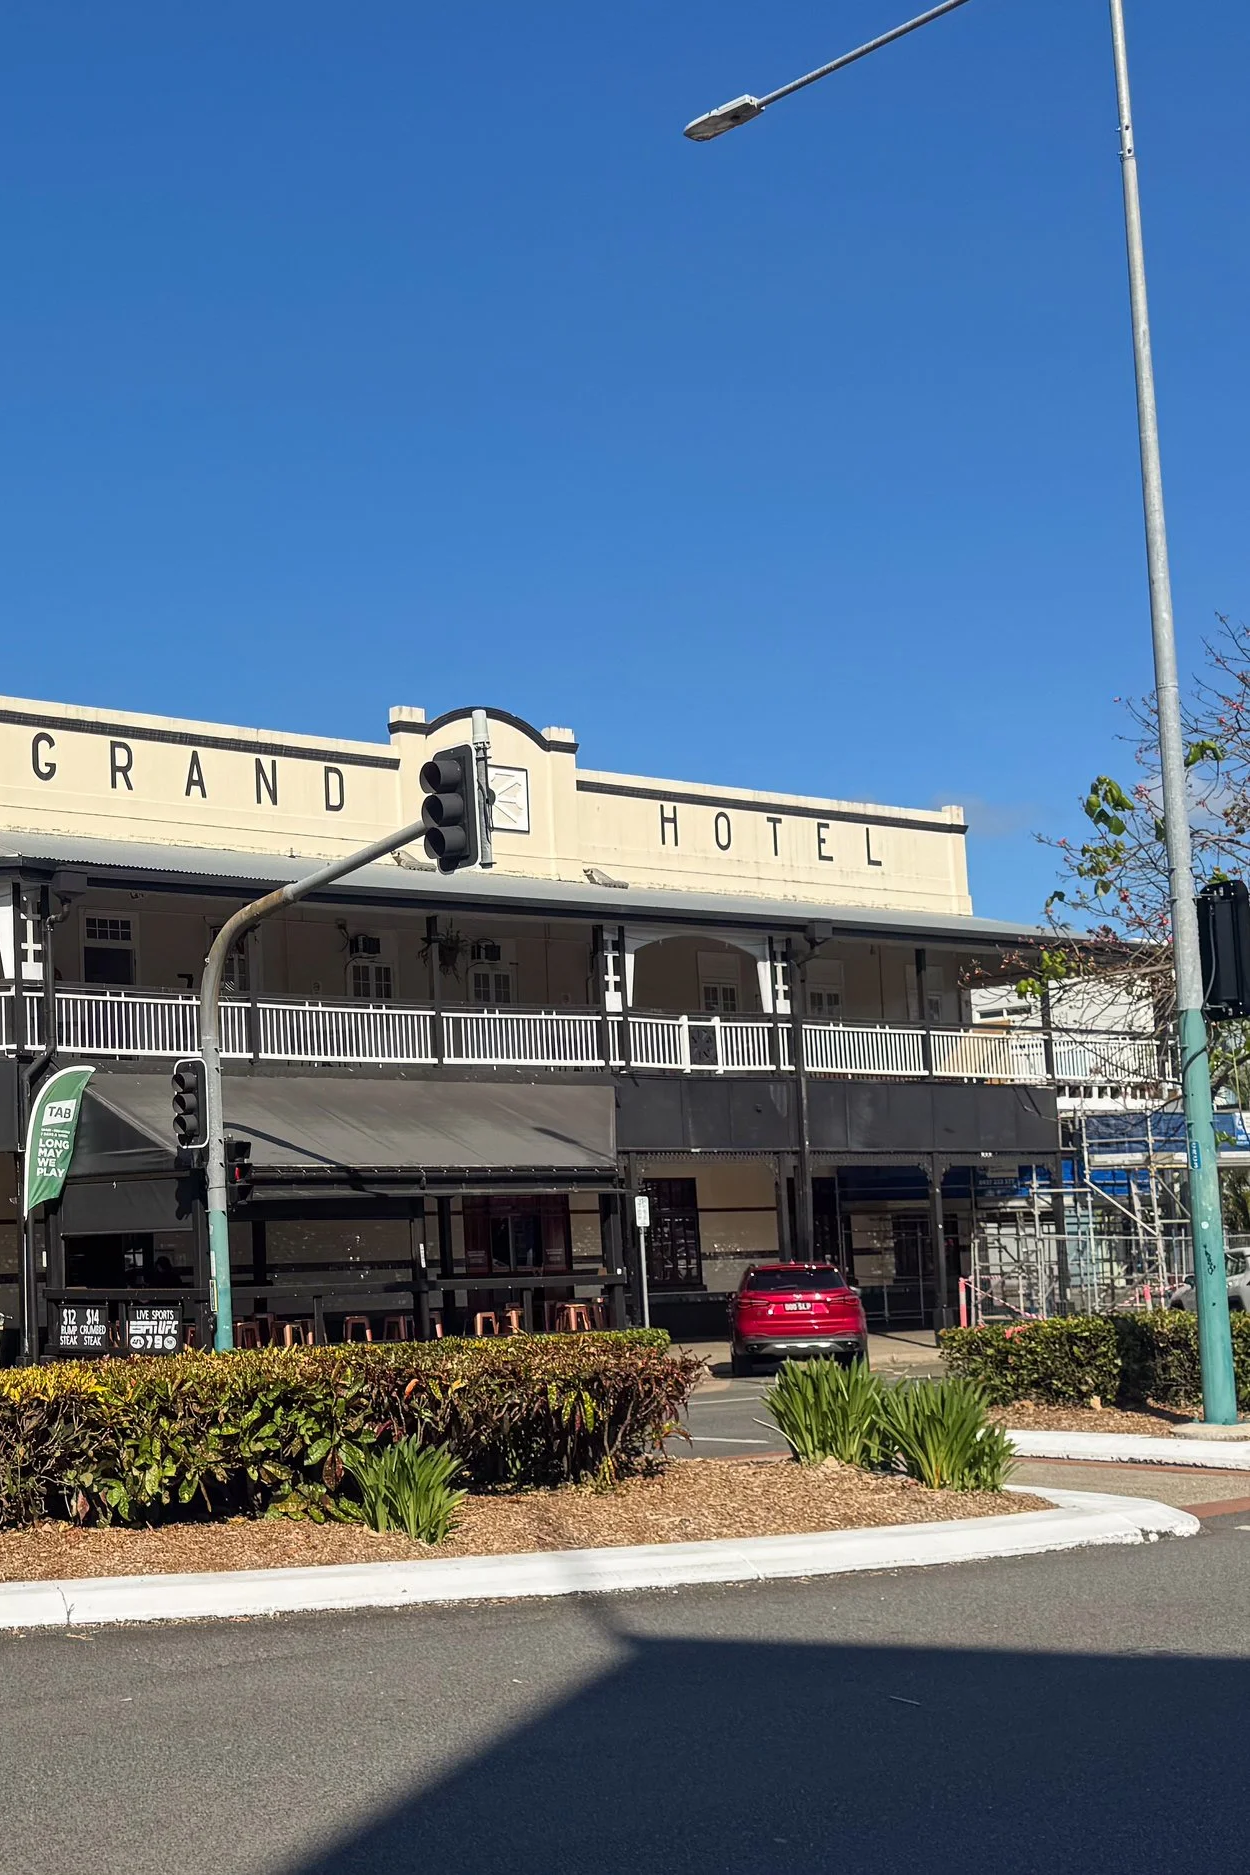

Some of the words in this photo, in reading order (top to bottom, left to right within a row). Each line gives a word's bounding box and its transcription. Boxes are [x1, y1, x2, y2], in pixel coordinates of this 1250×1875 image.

[31, 732, 345, 812] GRAND
[659, 803, 883, 867] HOTEL
[48, 1106, 72, 1119] TAB
[38, 1138, 70, 1150] LONG
[37, 1148, 63, 1158] MAY
[37, 1158, 56, 1167] WE
[36, 1167, 66, 1178] PLAY
[62, 1308, 77, 1325] $12
[85, 1308, 100, 1325] $14
[136, 1309, 149, 1320] LIVE
[151, 1309, 175, 1320] SPORTS
[60, 1325, 78, 1335] RUMP
[79, 1324, 107, 1335] CRUMBED
[158, 1320, 179, 1335] UFC
[59, 1335, 78, 1346] STEAK
[83, 1335, 102, 1346] STEAK
